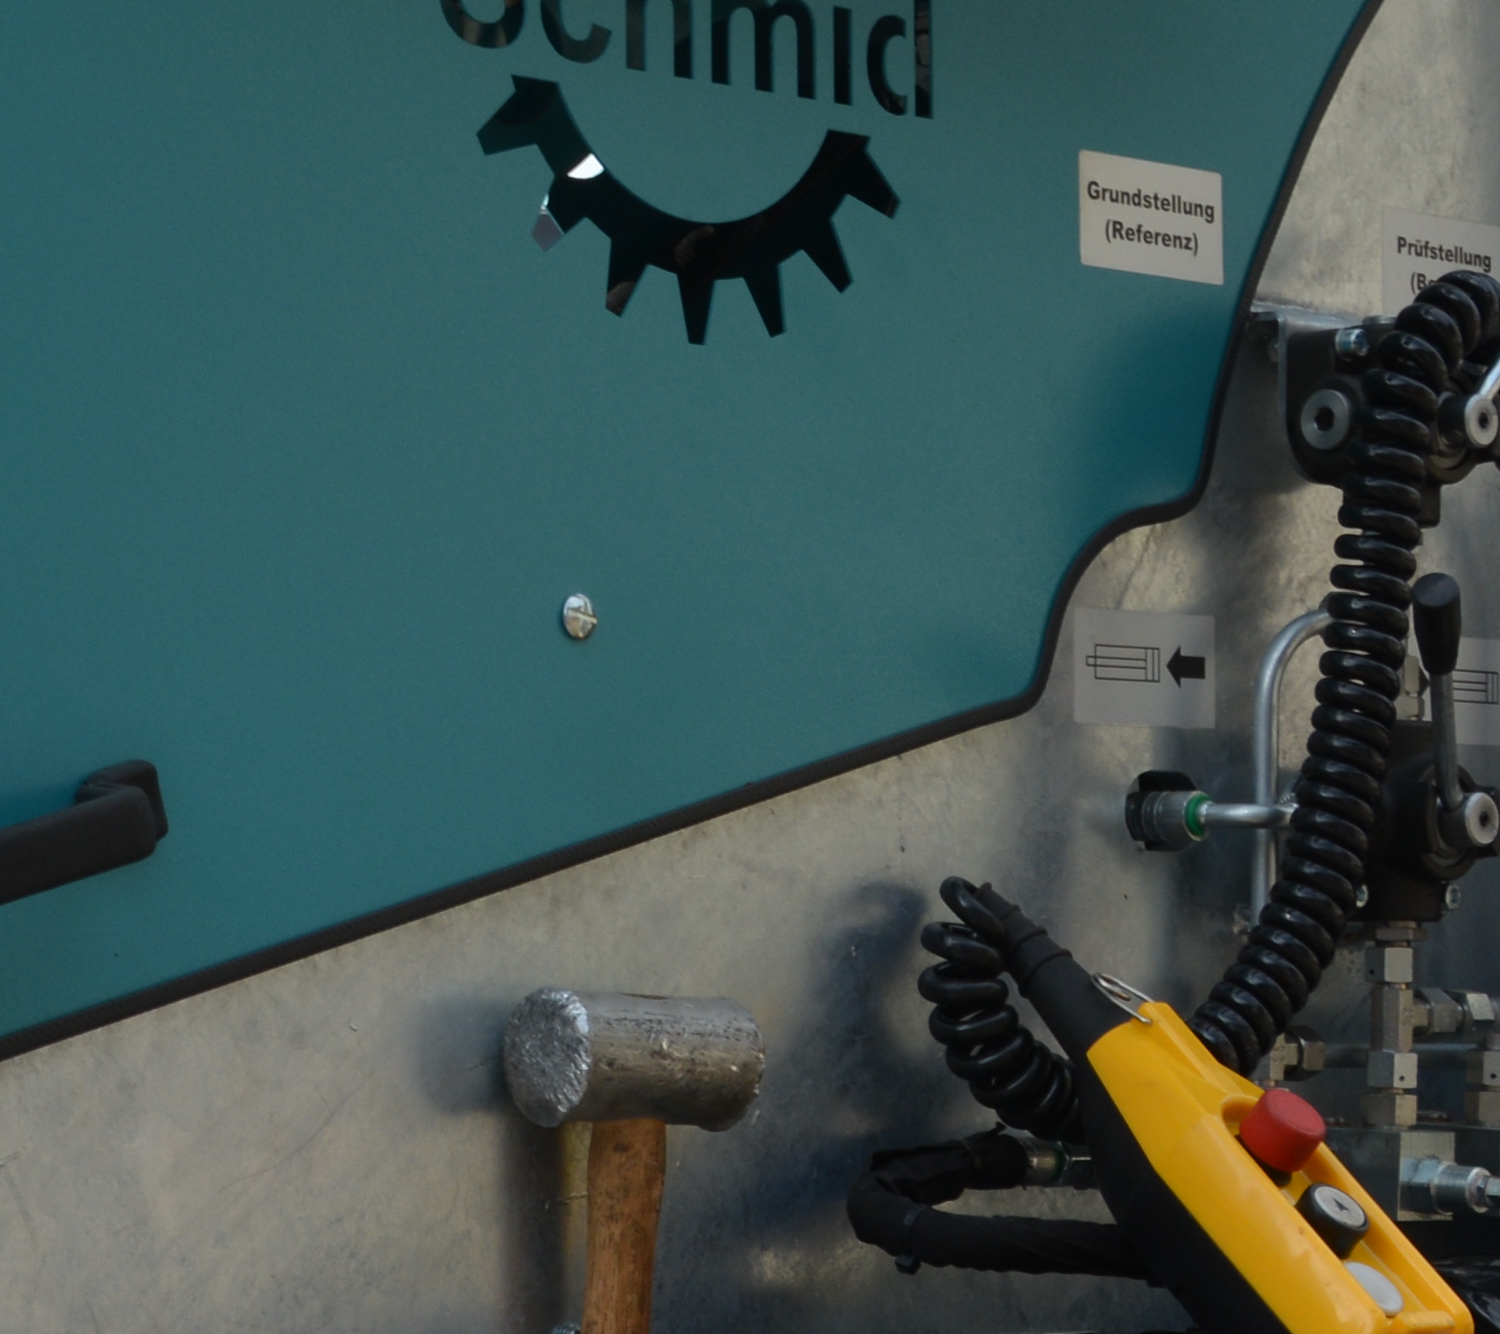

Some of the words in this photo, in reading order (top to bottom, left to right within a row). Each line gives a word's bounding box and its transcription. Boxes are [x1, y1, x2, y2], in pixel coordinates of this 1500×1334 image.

[1086, 180, 1215, 224] Grundstellung
[1105, 218, 1199, 257] (Referenz)
[1396, 235, 1492, 274] Prüfstellung
